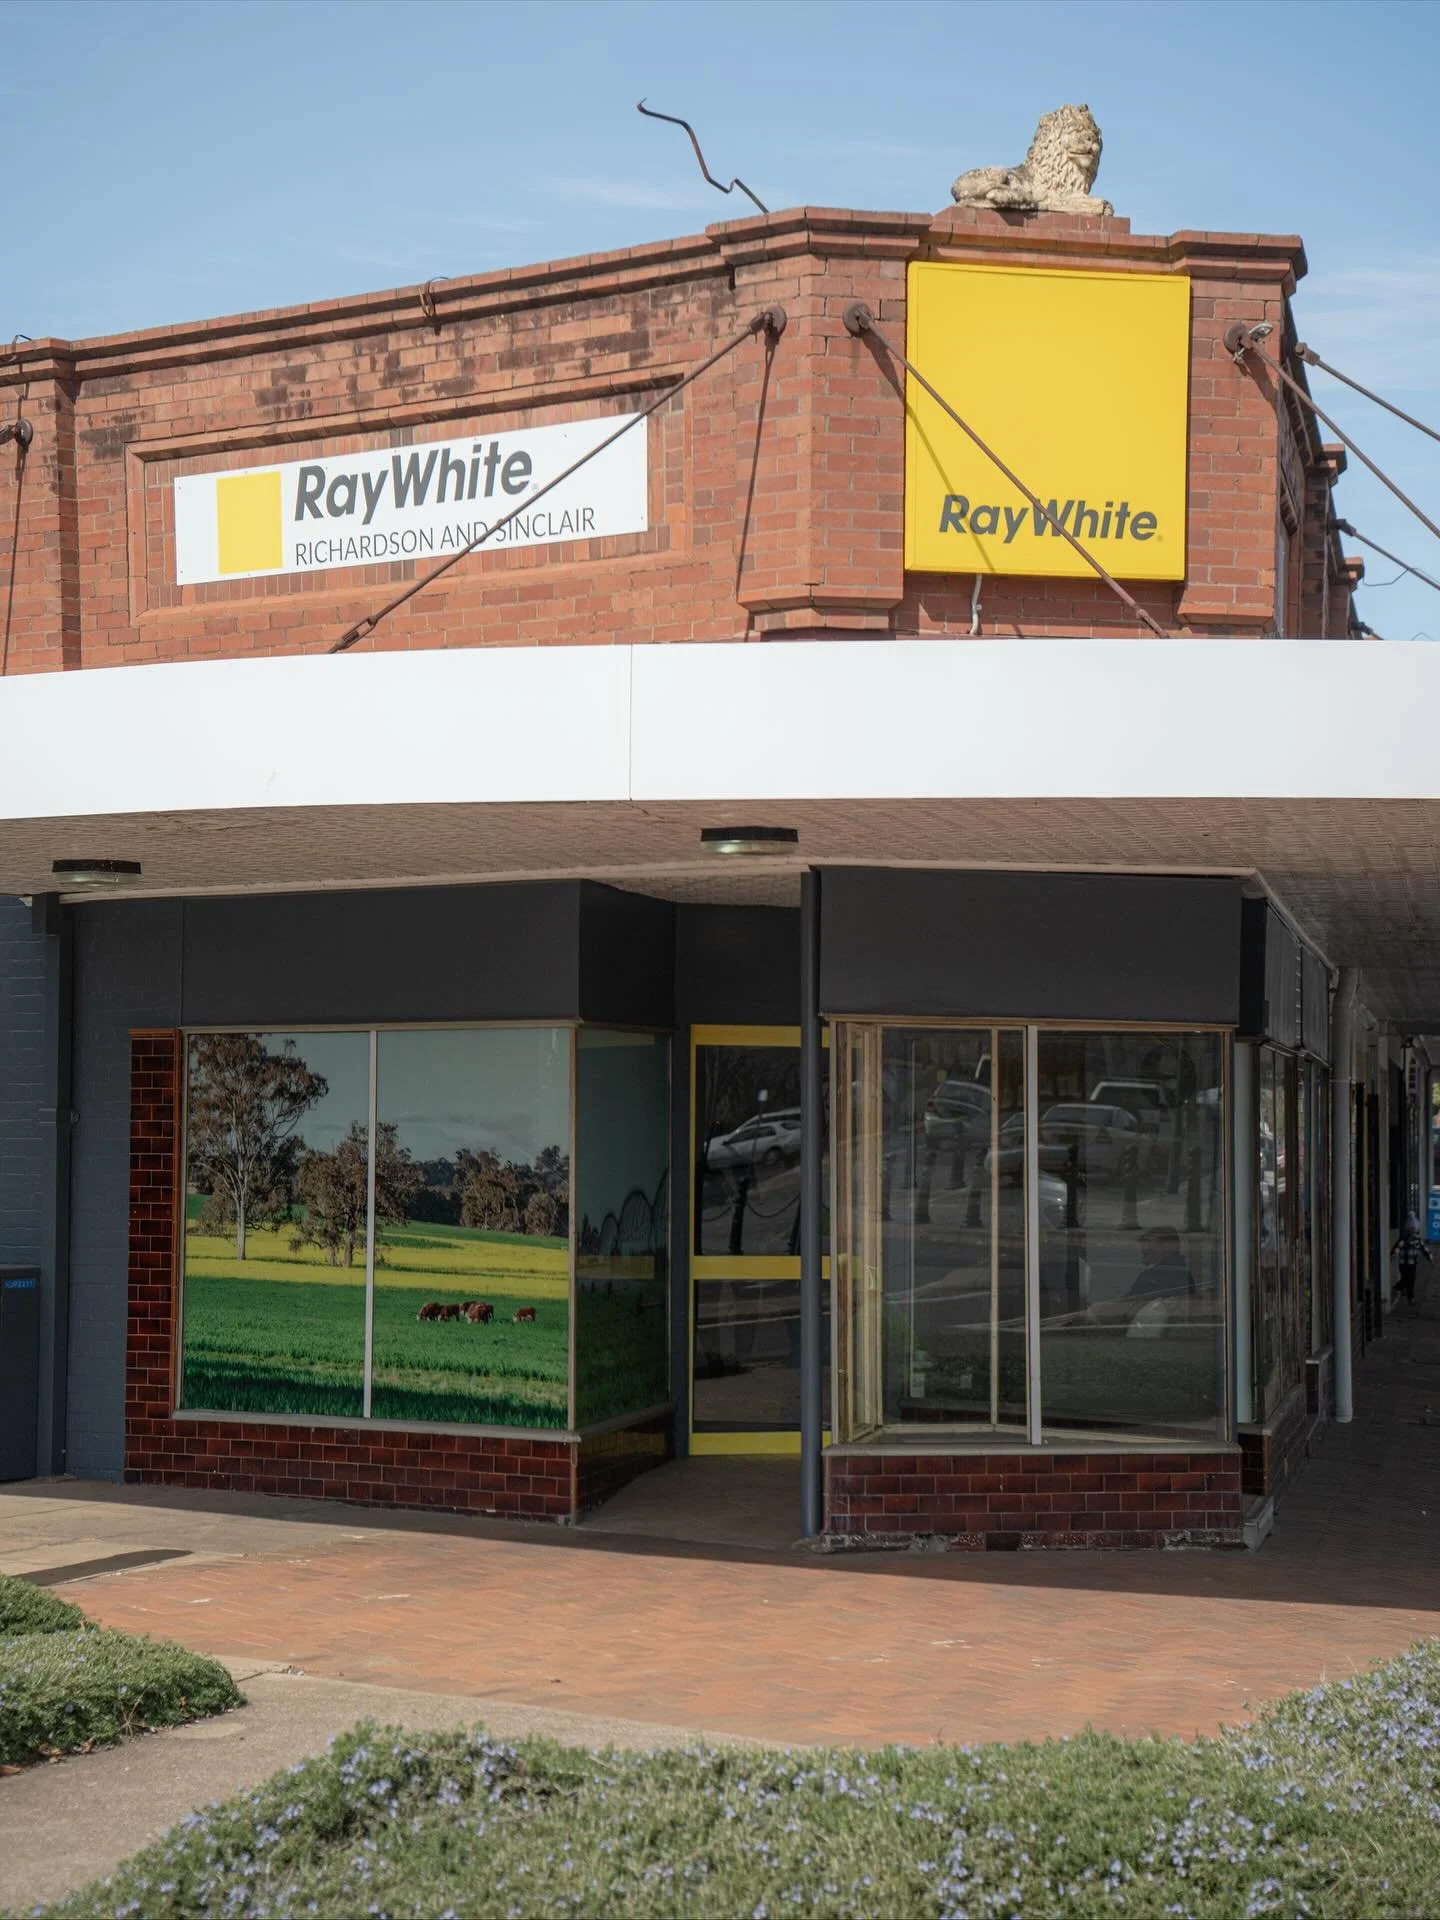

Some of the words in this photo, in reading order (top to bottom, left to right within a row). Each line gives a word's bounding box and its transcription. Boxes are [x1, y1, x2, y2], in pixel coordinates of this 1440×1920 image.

[296, 528, 433, 566] RICHARDSON
[440, 521, 488, 549] AND
[495, 507, 595, 542] SINCLAIR
